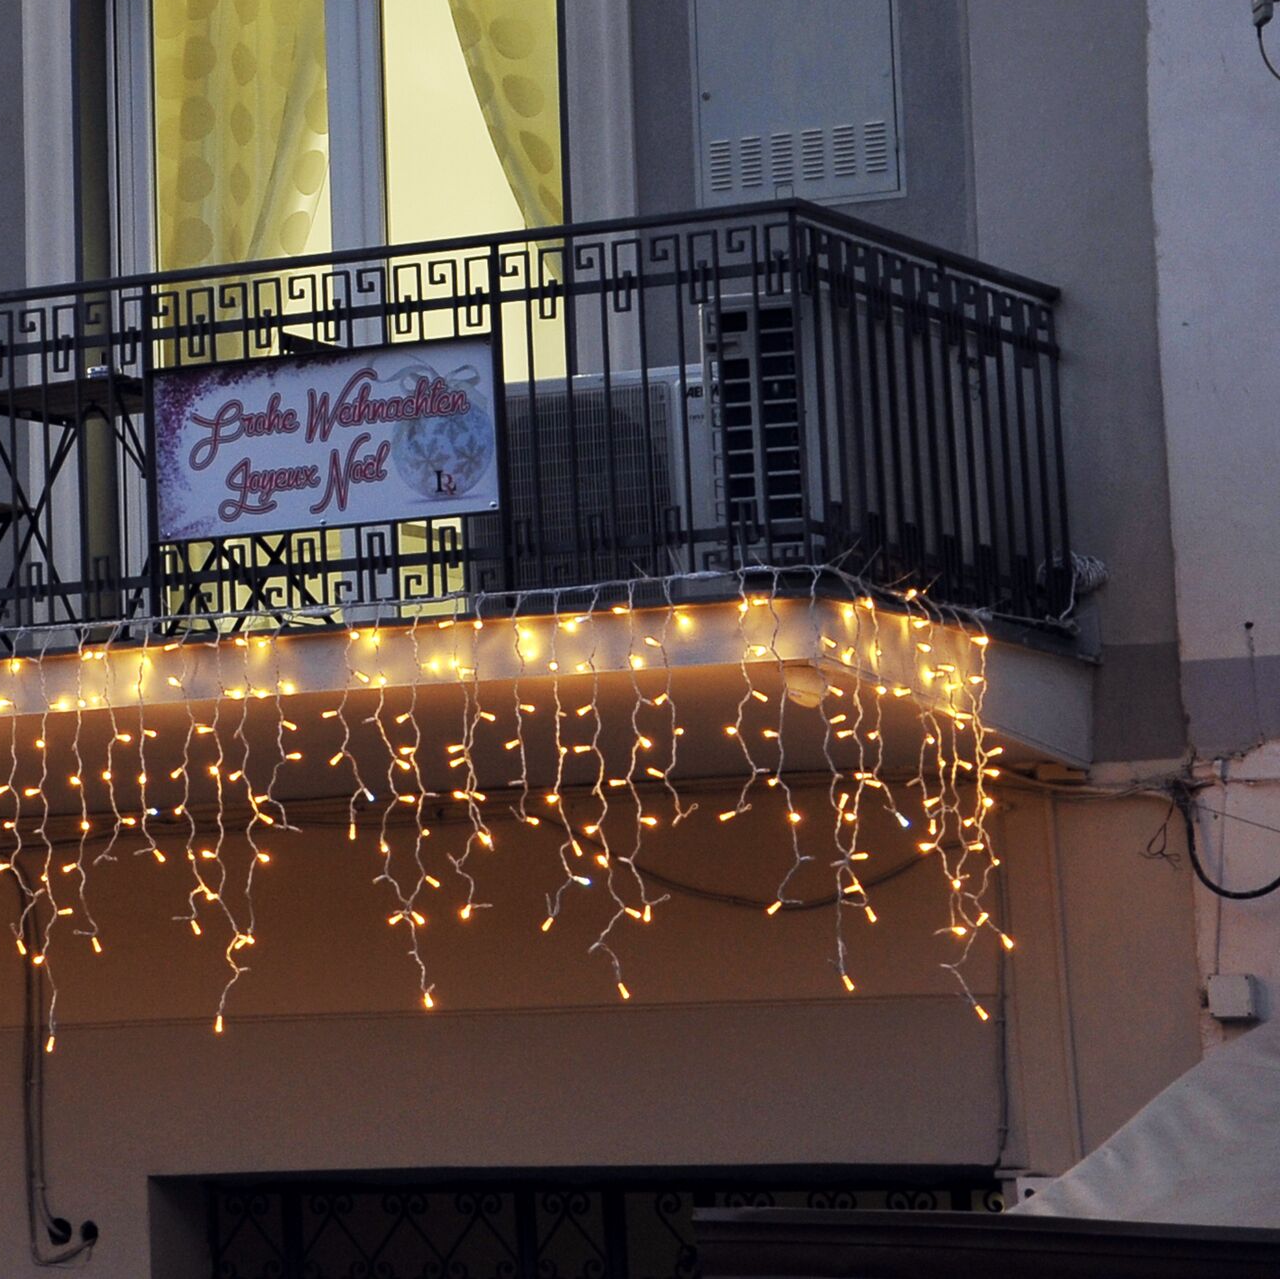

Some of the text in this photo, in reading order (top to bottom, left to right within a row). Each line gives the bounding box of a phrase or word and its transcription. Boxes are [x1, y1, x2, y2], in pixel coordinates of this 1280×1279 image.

[190, 368, 470, 470] Frohe Weihnachten
[218, 432, 390, 523] Joyeux Noël
